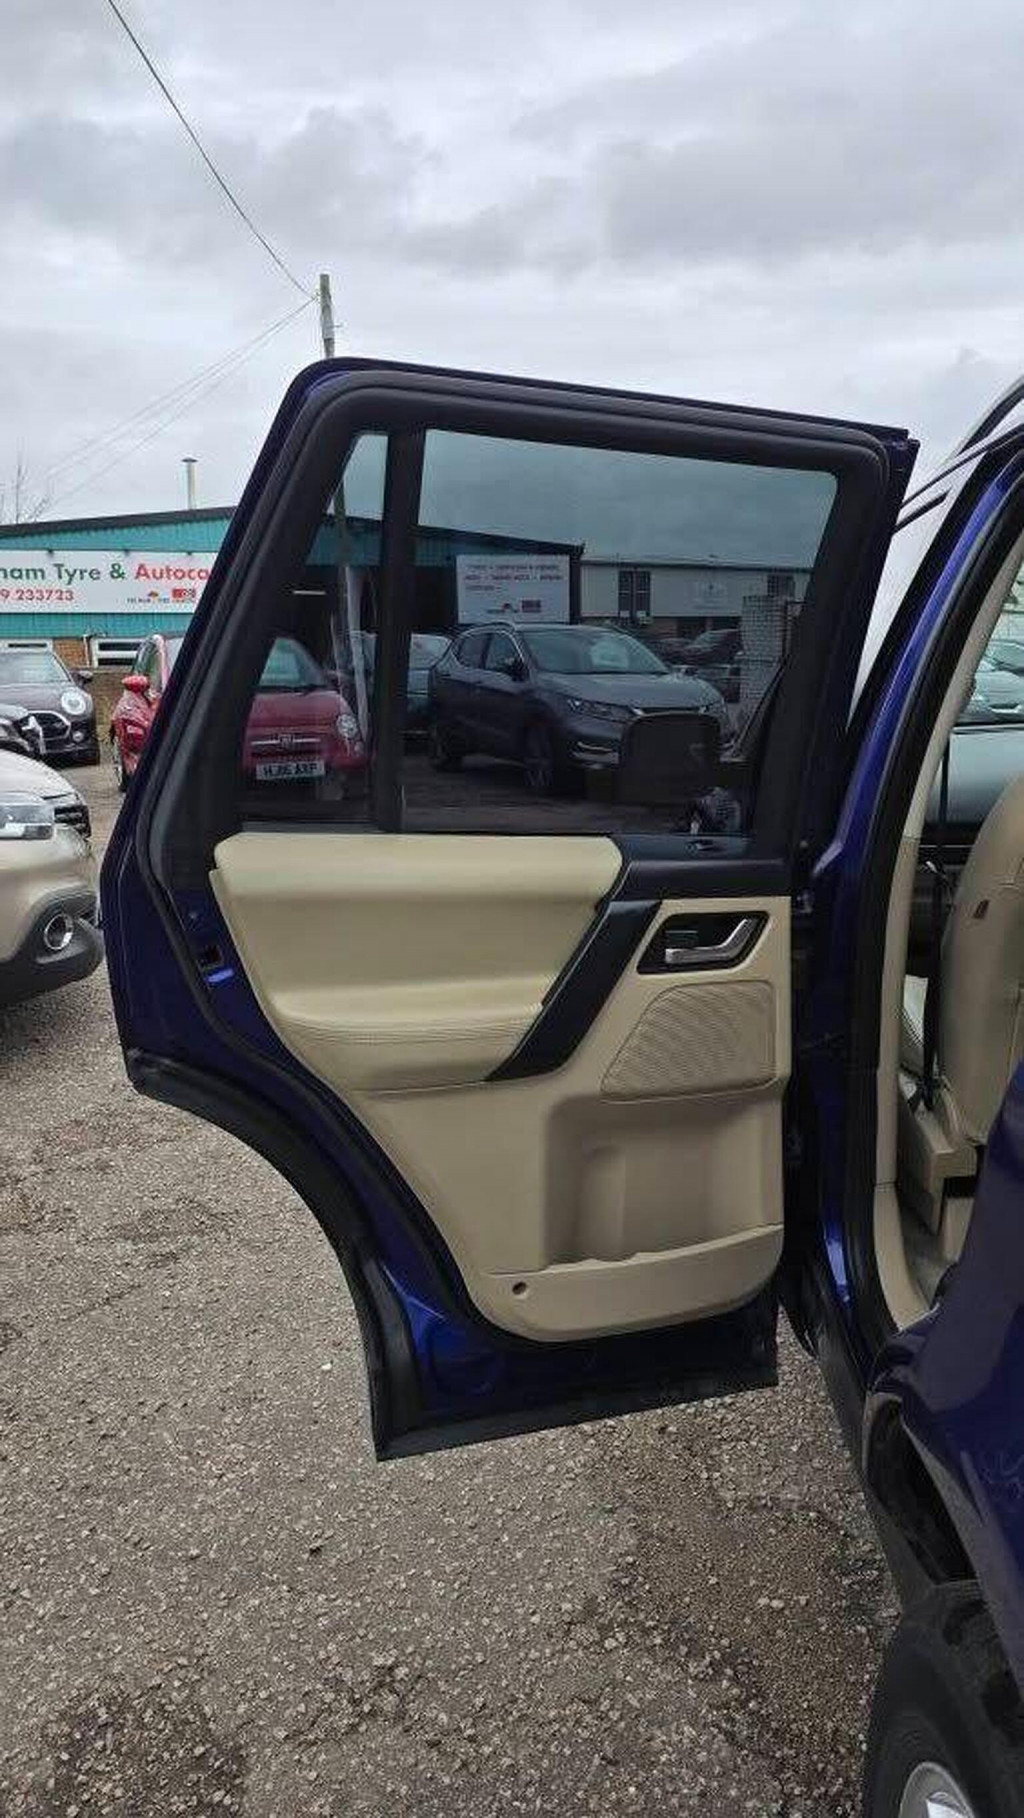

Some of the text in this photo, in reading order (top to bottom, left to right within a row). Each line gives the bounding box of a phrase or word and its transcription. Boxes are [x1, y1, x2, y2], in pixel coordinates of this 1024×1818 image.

[53, 563, 101, 585] Tyre
[110, 562, 125, 580] &
[16, 589, 74, 601] 233723
